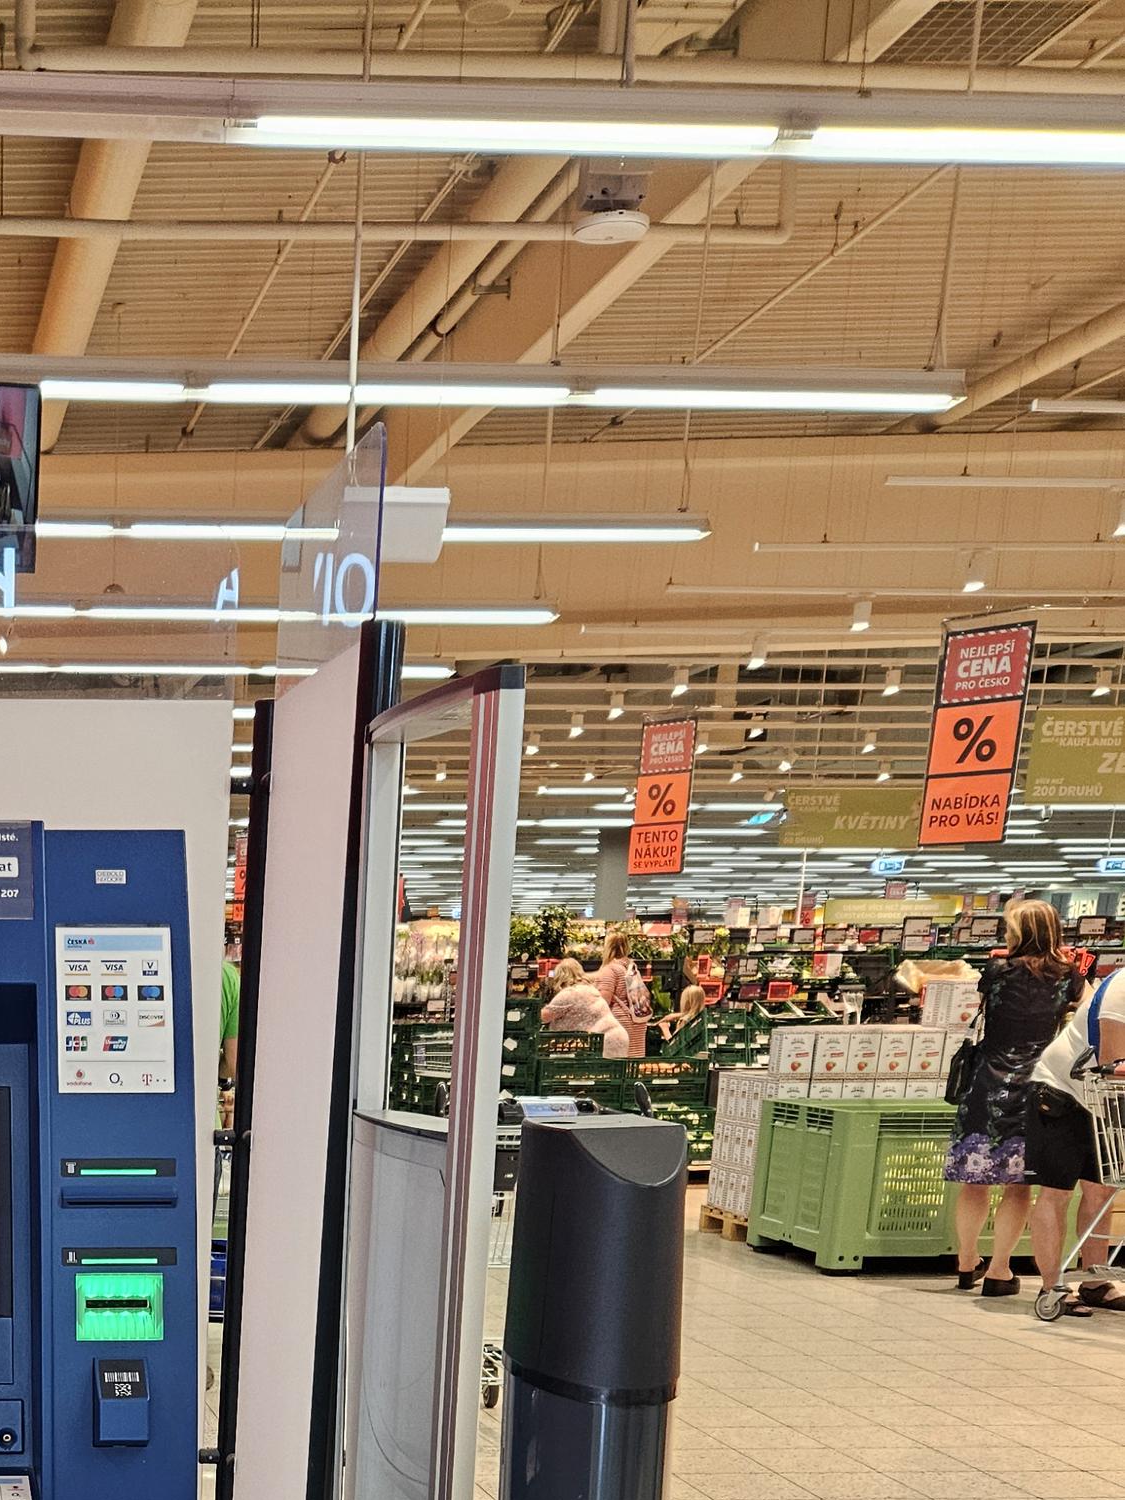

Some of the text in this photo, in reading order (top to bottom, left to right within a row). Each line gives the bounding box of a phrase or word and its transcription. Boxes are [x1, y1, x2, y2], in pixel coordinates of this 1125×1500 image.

[960, 639, 1015, 659] NEJLEPŠÍ
[957, 655, 1011, 679] CENA
[955, 676, 1010, 691] PRO ČESKO
[1041, 716, 1124, 736] ČERSTVÉ
[650, 740, 685, 756] CENA
[1033, 782, 1103, 796] 200 DRUHŮ
[931, 794, 1000, 811] NABÍDKA
[833, 813, 909, 830] KVĚTINY
[929, 811, 999, 828] PRO VÁS!
[637, 830, 678, 844] TENTO
[634, 845, 677, 859] NÁKUP
[1, 889, 19, 898] 207
